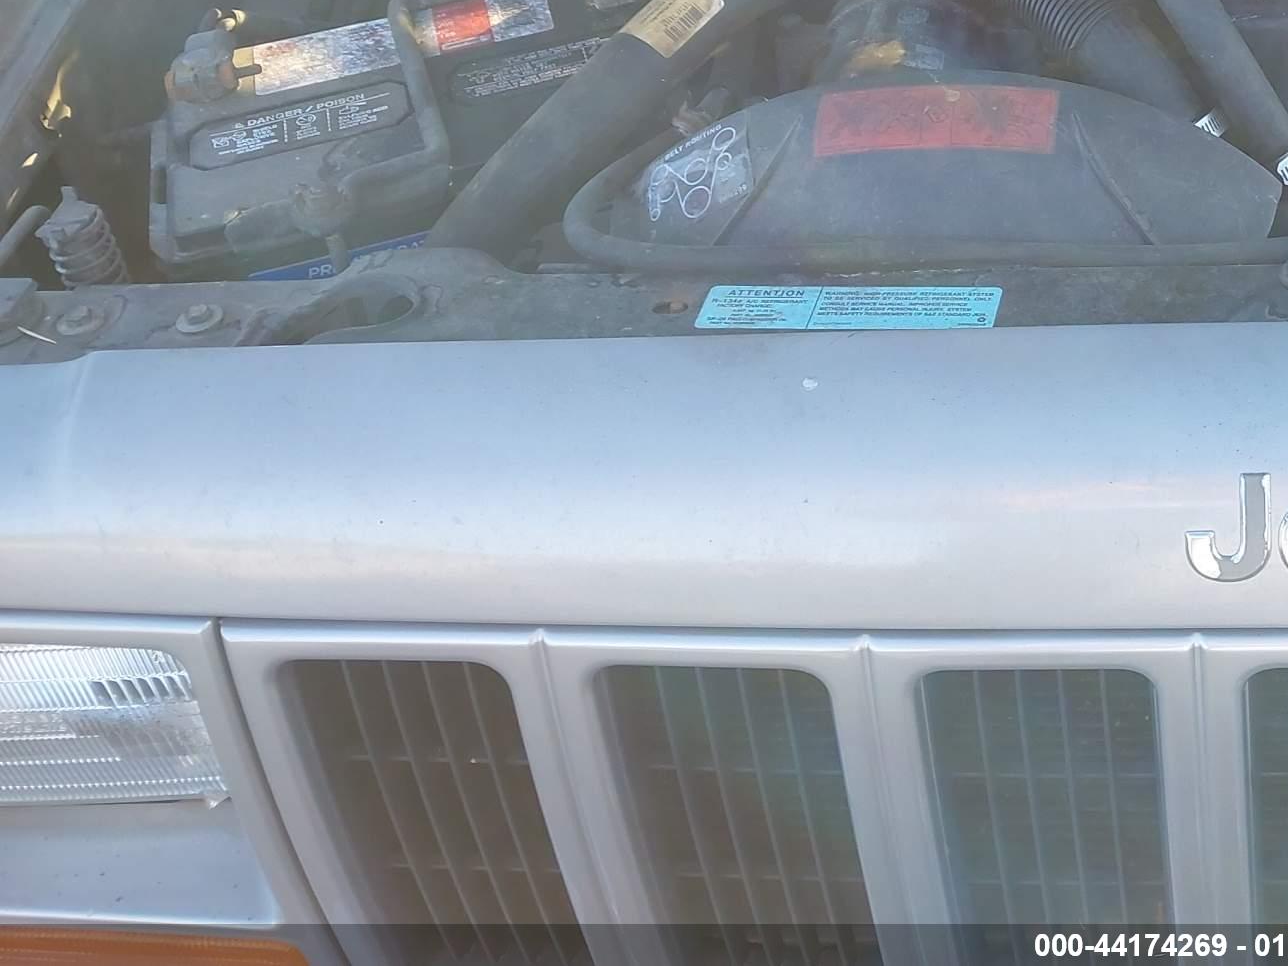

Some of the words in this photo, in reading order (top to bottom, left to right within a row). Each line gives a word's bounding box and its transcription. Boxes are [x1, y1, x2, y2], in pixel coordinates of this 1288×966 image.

[247, 108, 303, 126] DANGER
[316, 93, 365, 110] POISON
[664, 144, 684, 161] BELT
[728, 289, 805, 297] ATTENTION
